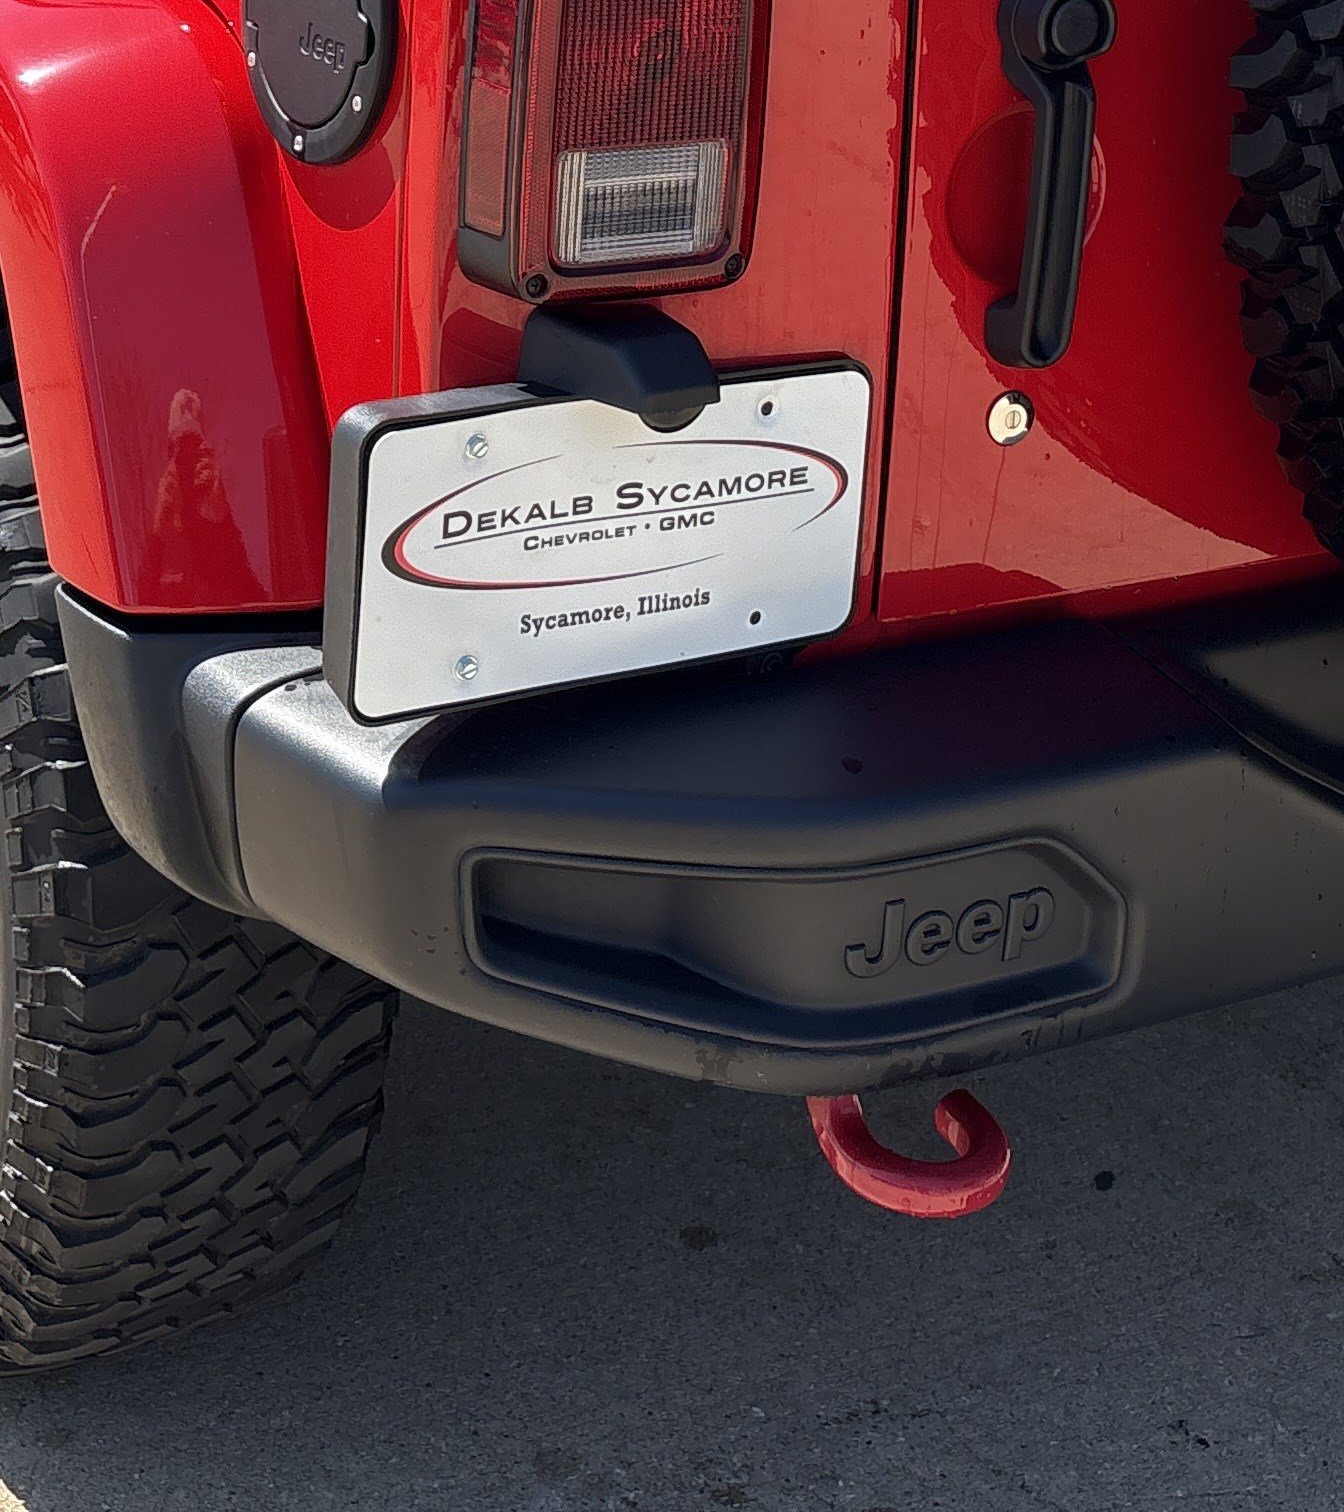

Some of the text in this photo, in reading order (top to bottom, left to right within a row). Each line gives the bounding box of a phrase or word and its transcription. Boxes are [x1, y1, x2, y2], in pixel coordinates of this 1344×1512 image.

[298, 21, 346, 75] Jeep
[659, 510, 716, 533] GMC
[519, 587, 711, 638] Sycamore, Illinois
[844, 886, 1055, 979] Jeep
